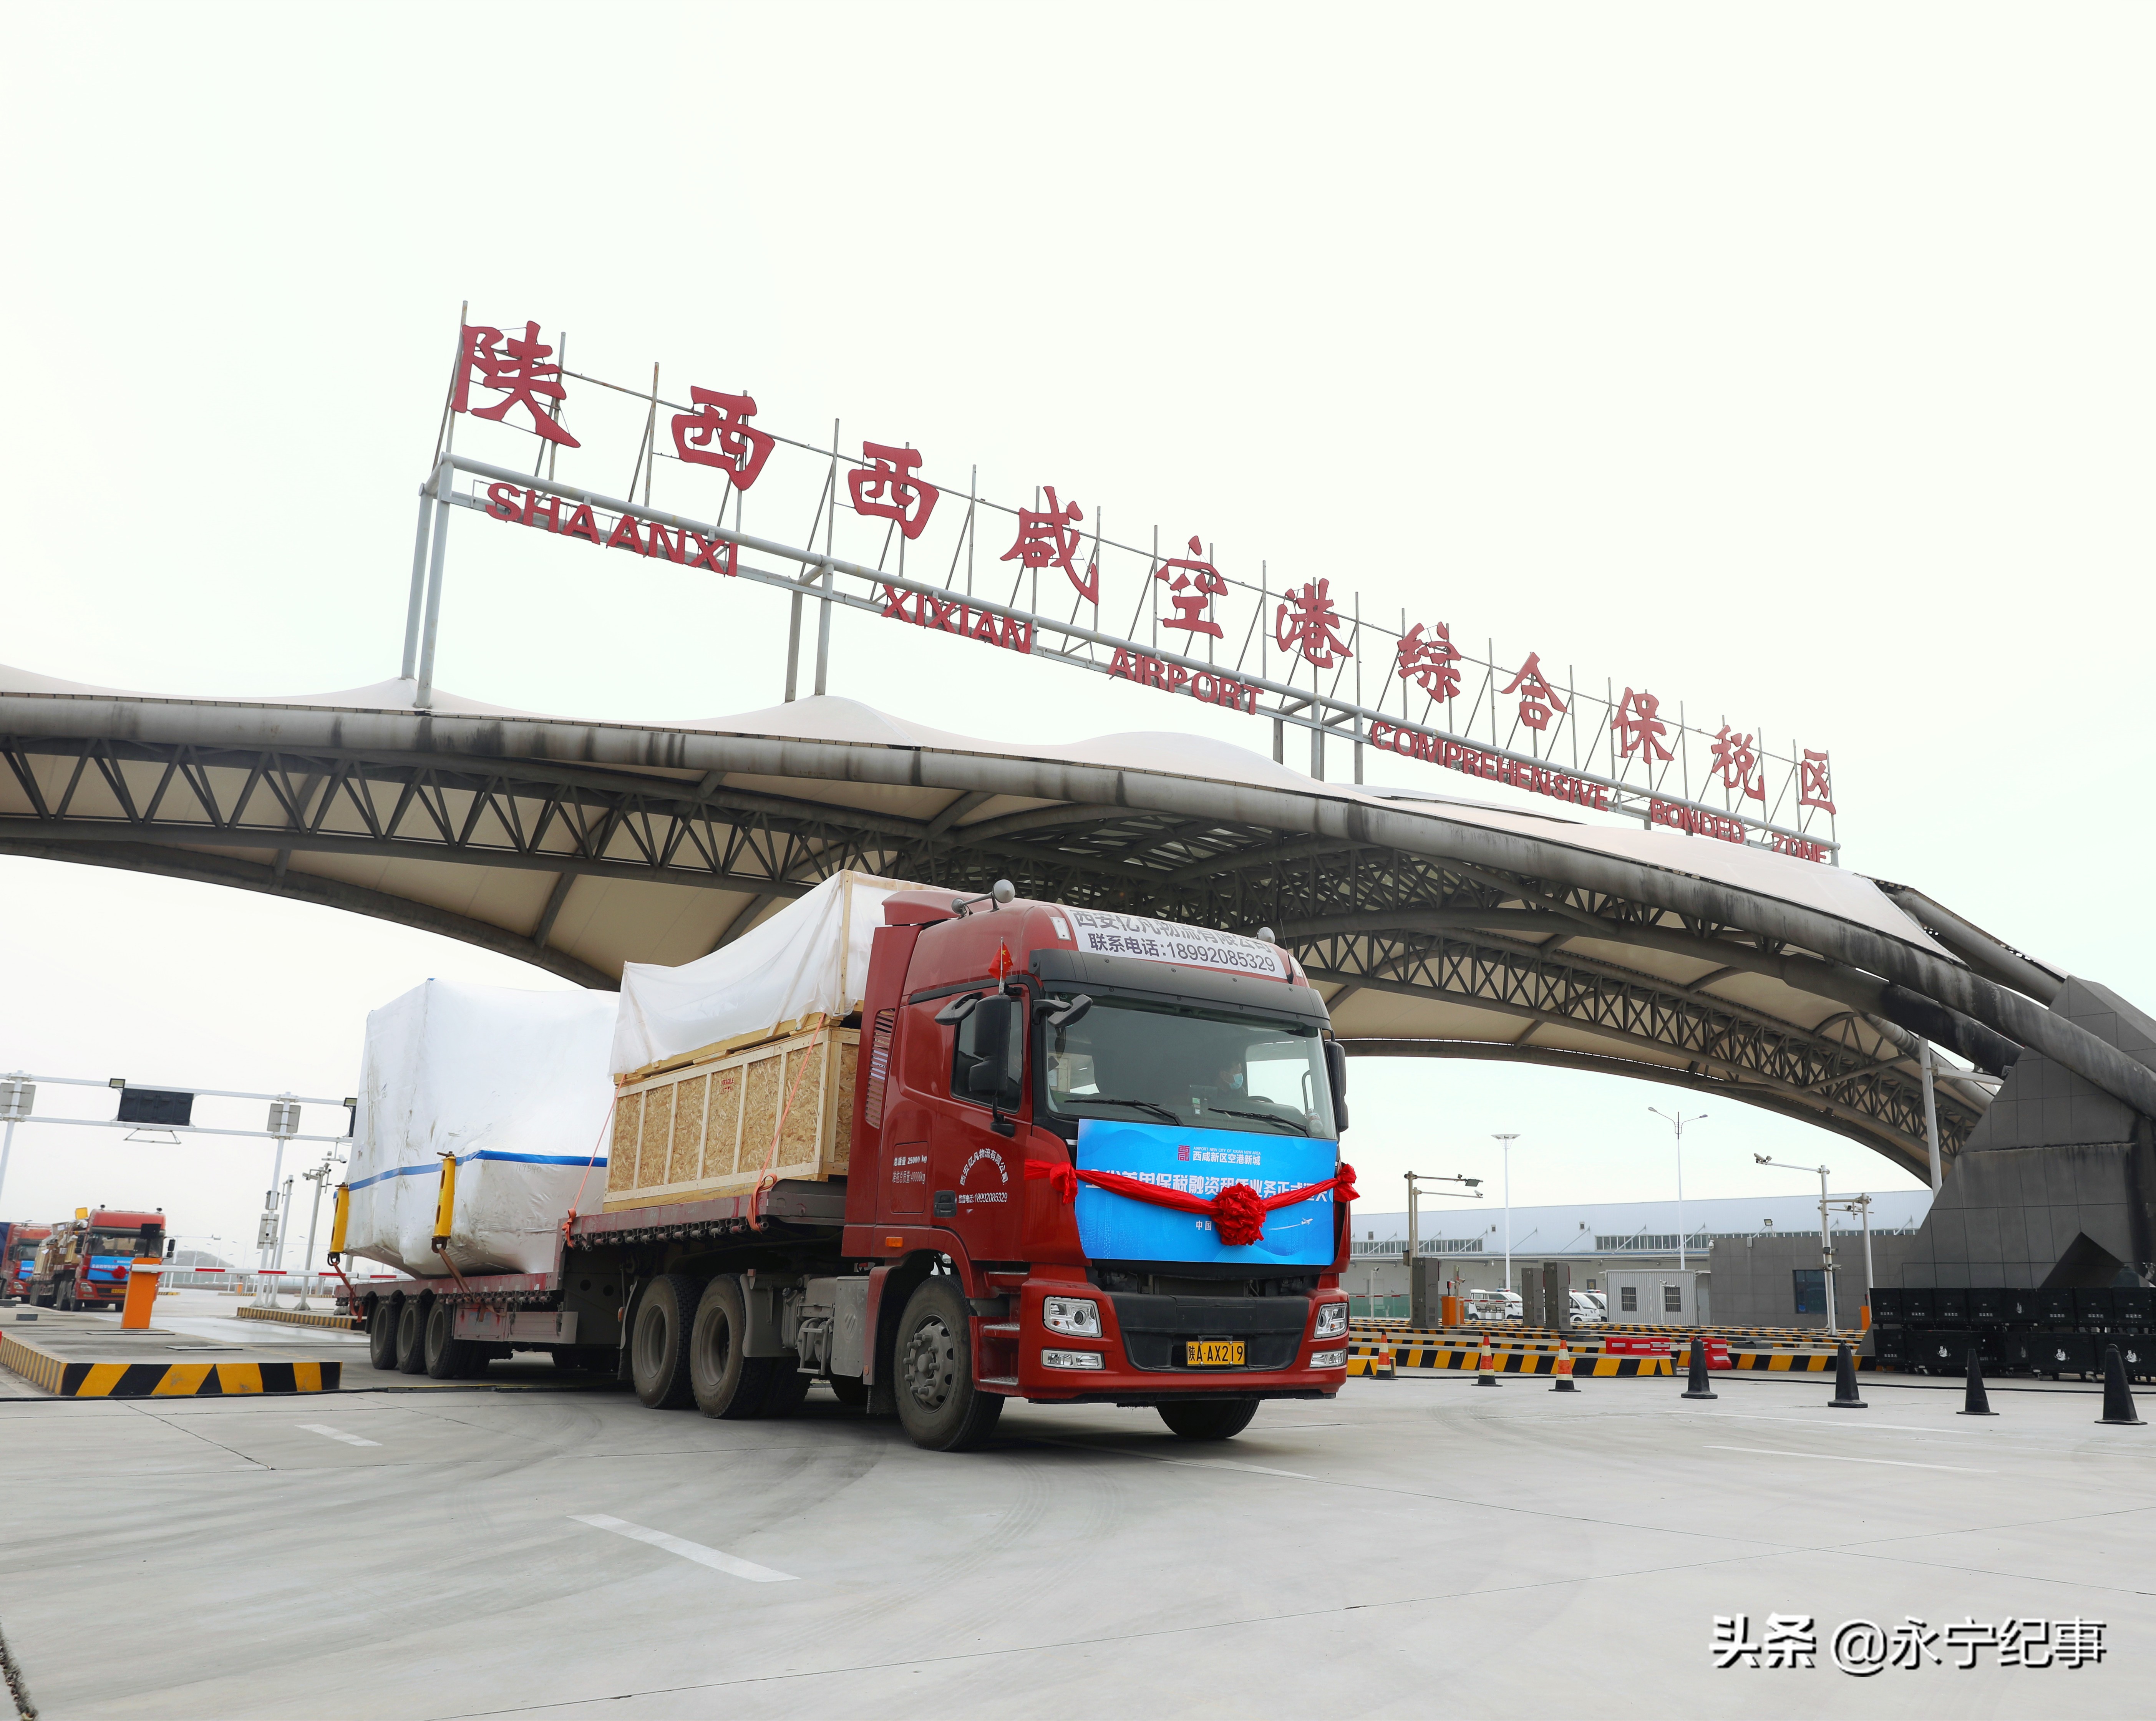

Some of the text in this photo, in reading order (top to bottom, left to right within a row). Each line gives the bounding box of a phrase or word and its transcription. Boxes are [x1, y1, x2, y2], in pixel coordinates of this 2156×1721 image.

[451, 320, 1836, 814] 陕西西咸空港综合保税区
[485, 482, 1831, 863] SHAANXI XIXIAN AIRPORT COMPREHENSIVE BONDED ZONE
[1088, 933, 1276, 972] 联系电话:18992085329
[894, 1155, 927, 1166] 总质量 25000 kg
[959, 1148, 1008, 1186] 西安亿凡物流有限公司
[1192, 1151, 1261, 1166] 西咸新区空港新城
[1196, 1220, 1212, 1231] 中国
[1188, 1345, 1244, 1362] 陕A·AX219
